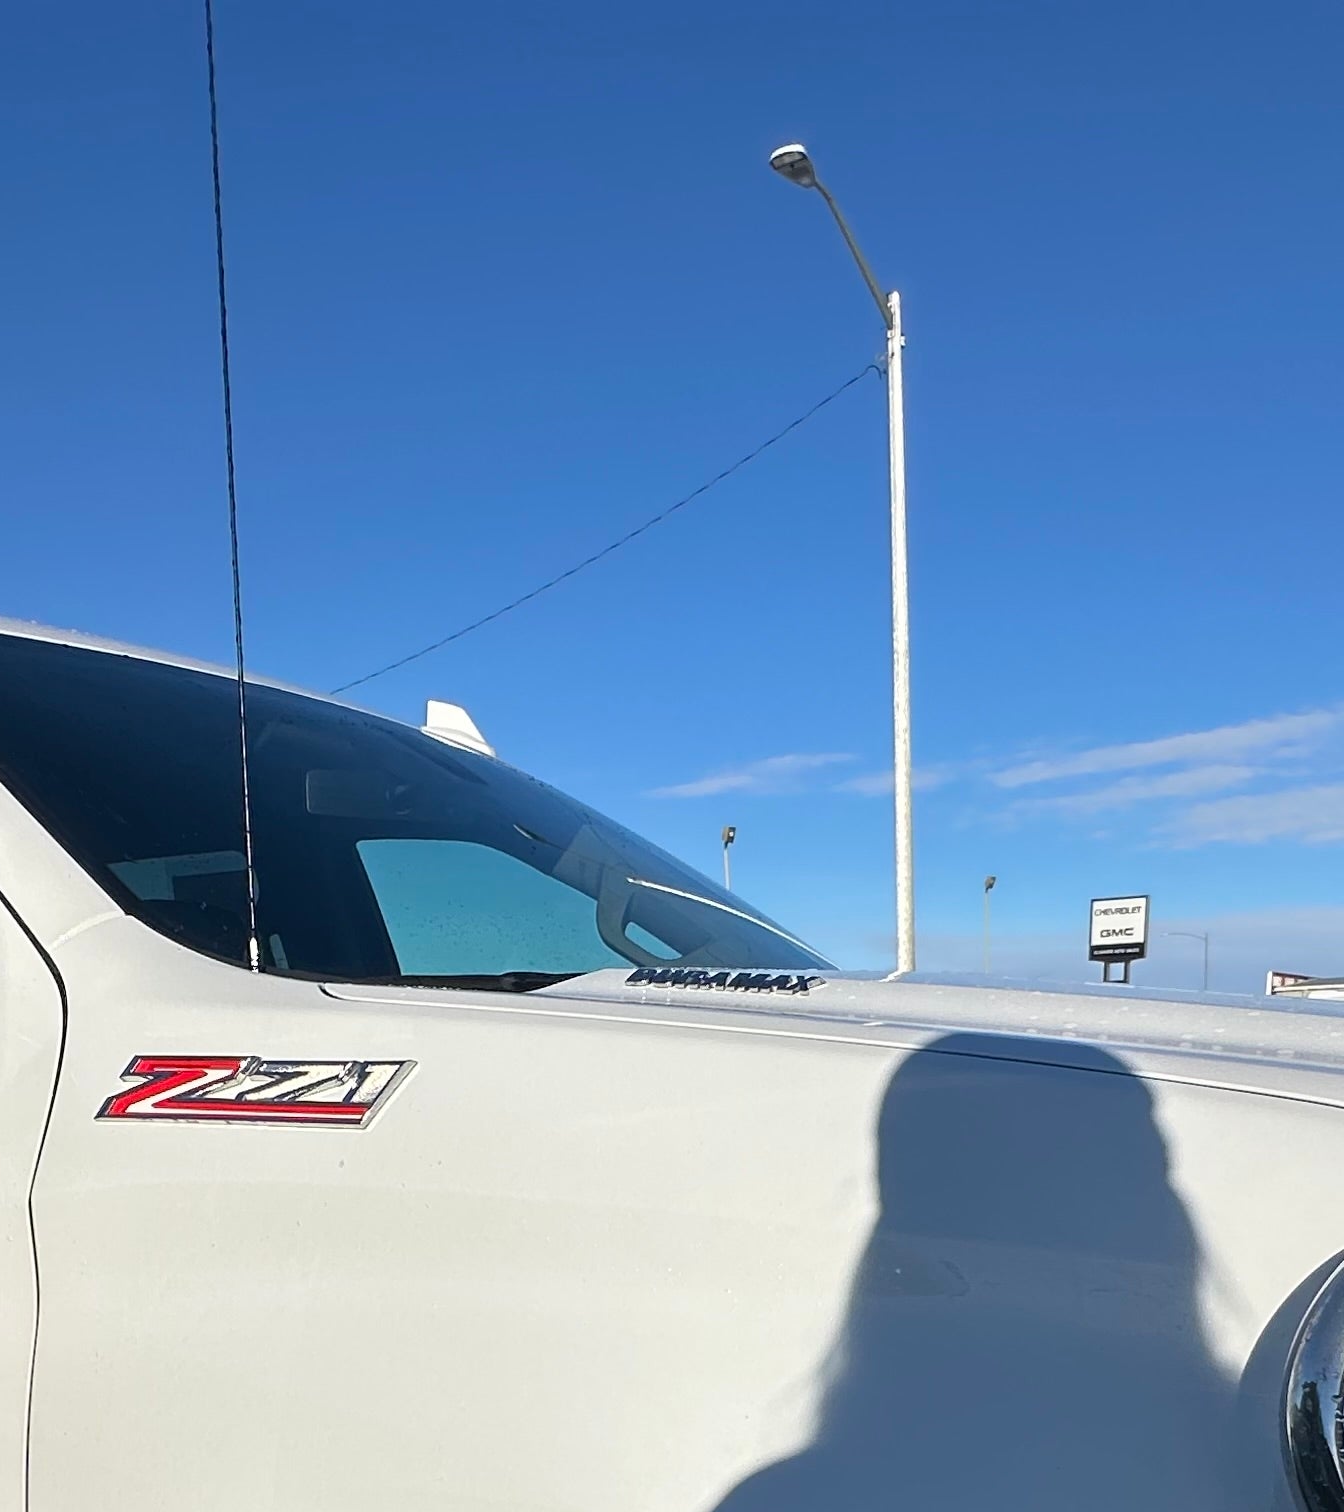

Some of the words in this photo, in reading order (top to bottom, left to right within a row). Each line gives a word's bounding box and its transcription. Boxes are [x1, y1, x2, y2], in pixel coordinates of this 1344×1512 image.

[1094, 906, 1142, 916] CHEVROLET
[1100, 927, 1134, 938] GMC
[625, 967, 827, 996] DURAMAX
[94, 1055, 419, 1130] Z71
